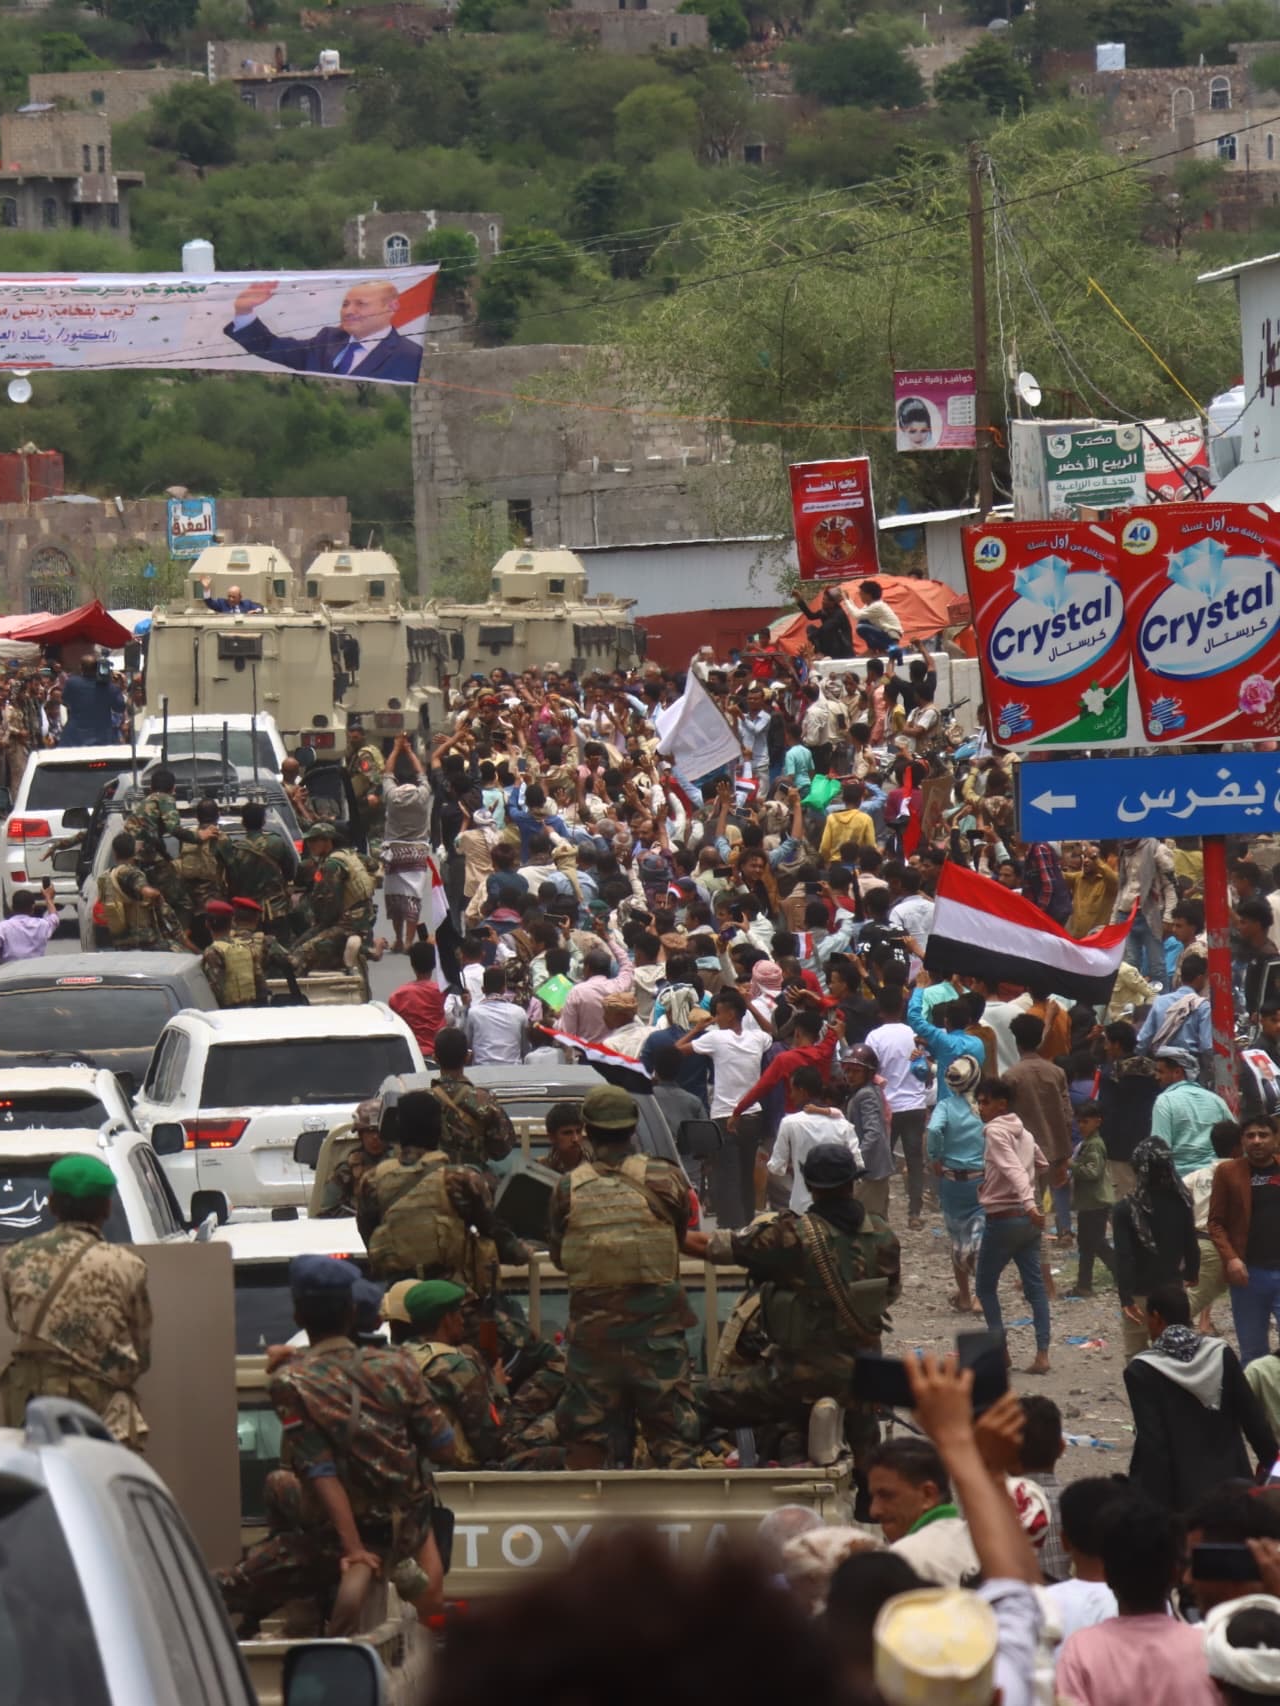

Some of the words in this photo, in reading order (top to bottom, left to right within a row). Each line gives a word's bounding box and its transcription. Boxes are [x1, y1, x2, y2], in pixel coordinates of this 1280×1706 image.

[12, 305, 44, 320] رئيس
[48, 304, 96, 319] بفخامة
[100, 304, 136, 319] ترحب
[20, 328, 51, 343] رشاد
[944, 374, 973, 385] كوافير
[1075, 434, 1112, 448] مكتب
[1056, 453, 1098, 475] الأخضر
[1102, 453, 1137, 473] الربيع
[1056, 480, 1090, 491] الزراعية
[1093, 475, 1137, 487] للمدخلات
[1129, 526, 1151, 542] 40
[981, 543, 1000, 558] 40
[1142, 571, 1273, 652] Crystal
[992, 585, 1112, 661] Crystal
[1204, 617, 1268, 654] كريستال
[1048, 628, 1107, 662] كريستال
[1117, 767, 1266, 823] يفرس
[455, 1523, 732, 1568] TOYTA
